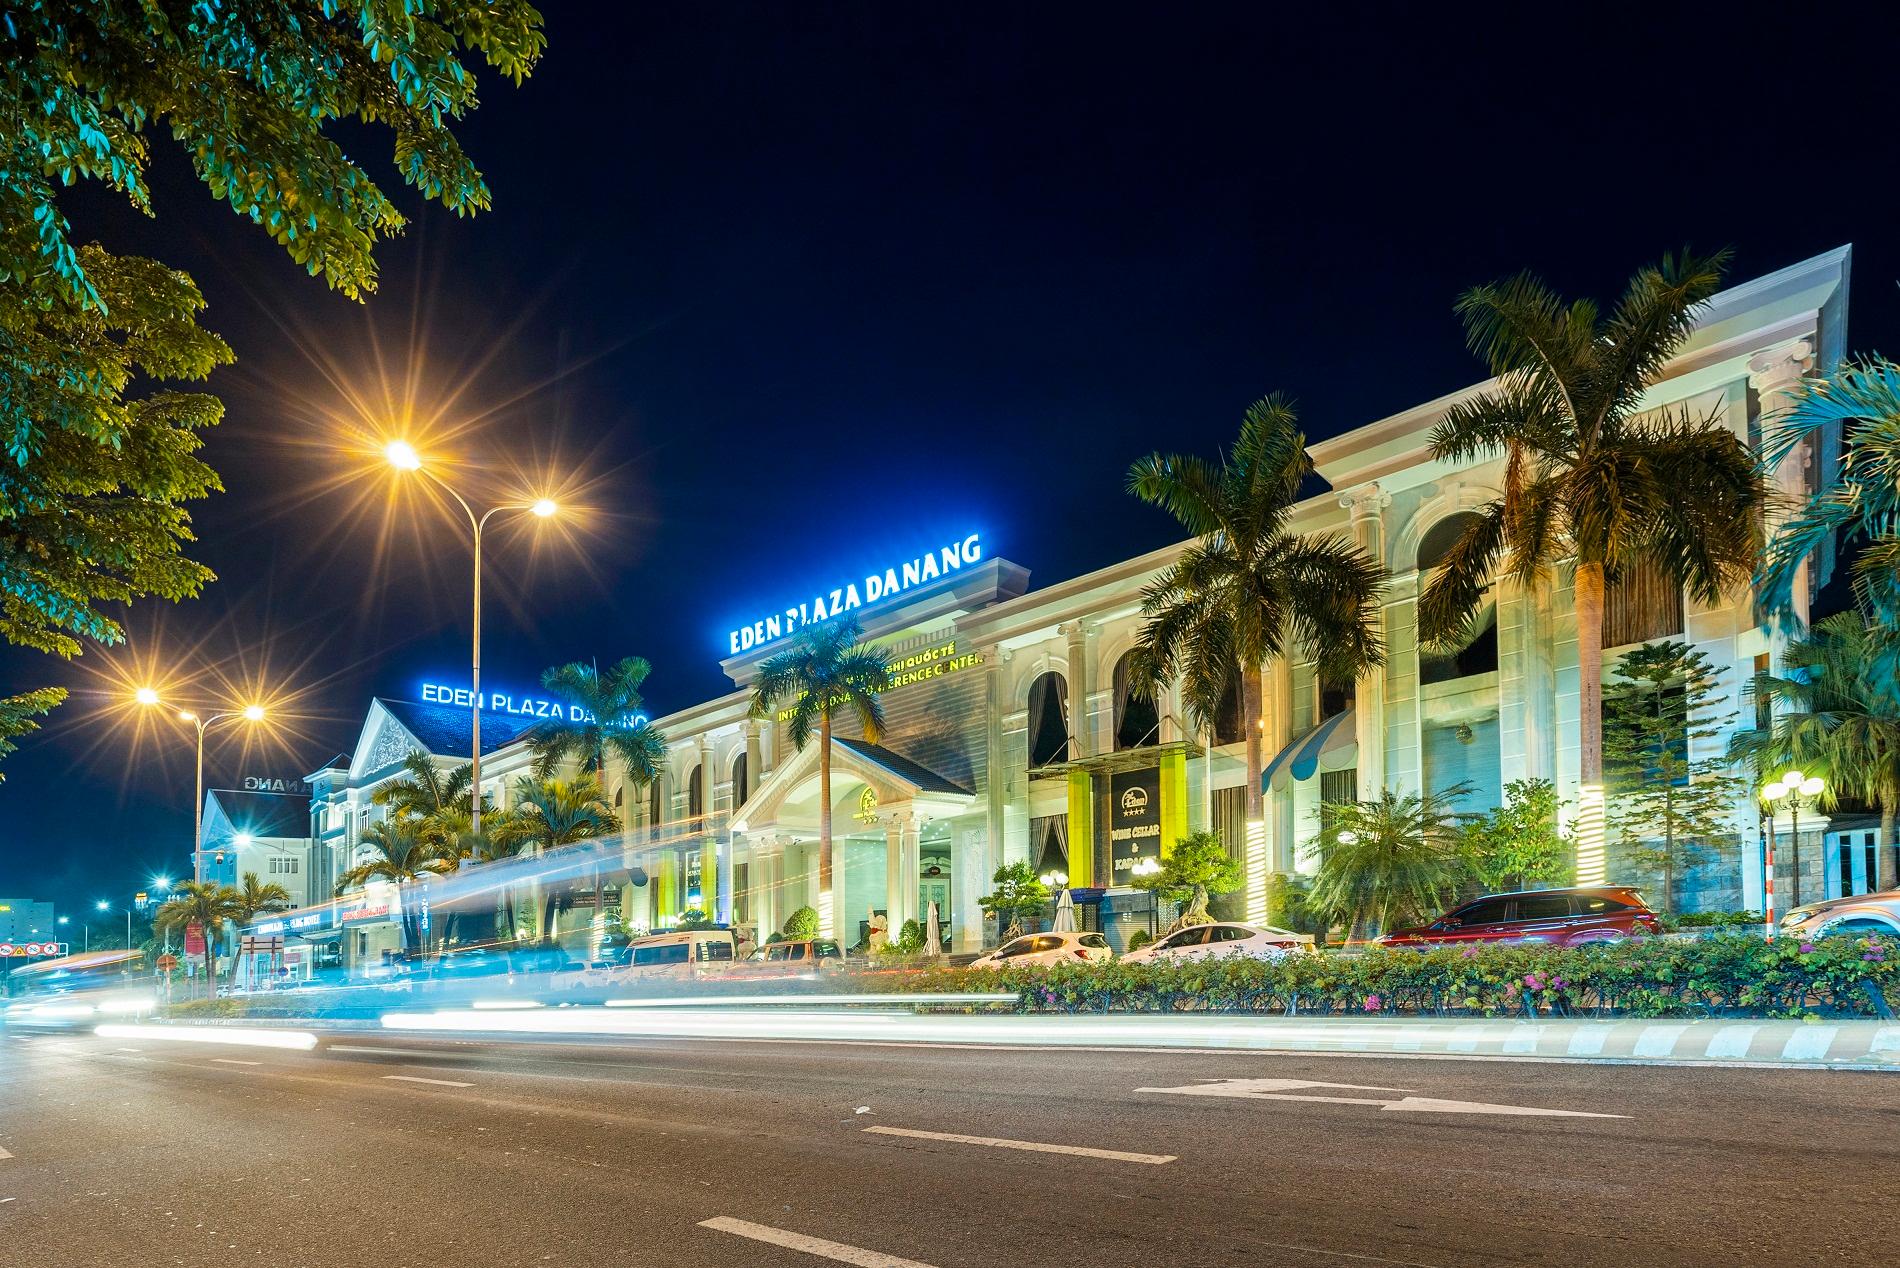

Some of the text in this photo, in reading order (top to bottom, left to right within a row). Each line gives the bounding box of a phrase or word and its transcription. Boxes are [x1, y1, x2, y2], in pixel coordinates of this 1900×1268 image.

[730, 615, 781, 655] EDEN
[786, 583, 861, 633] PLAZA
[422, 683, 484, 709] EDEN
[491, 693, 564, 720] PLAZA
[1132, 824, 1160, 838] CELLAR
